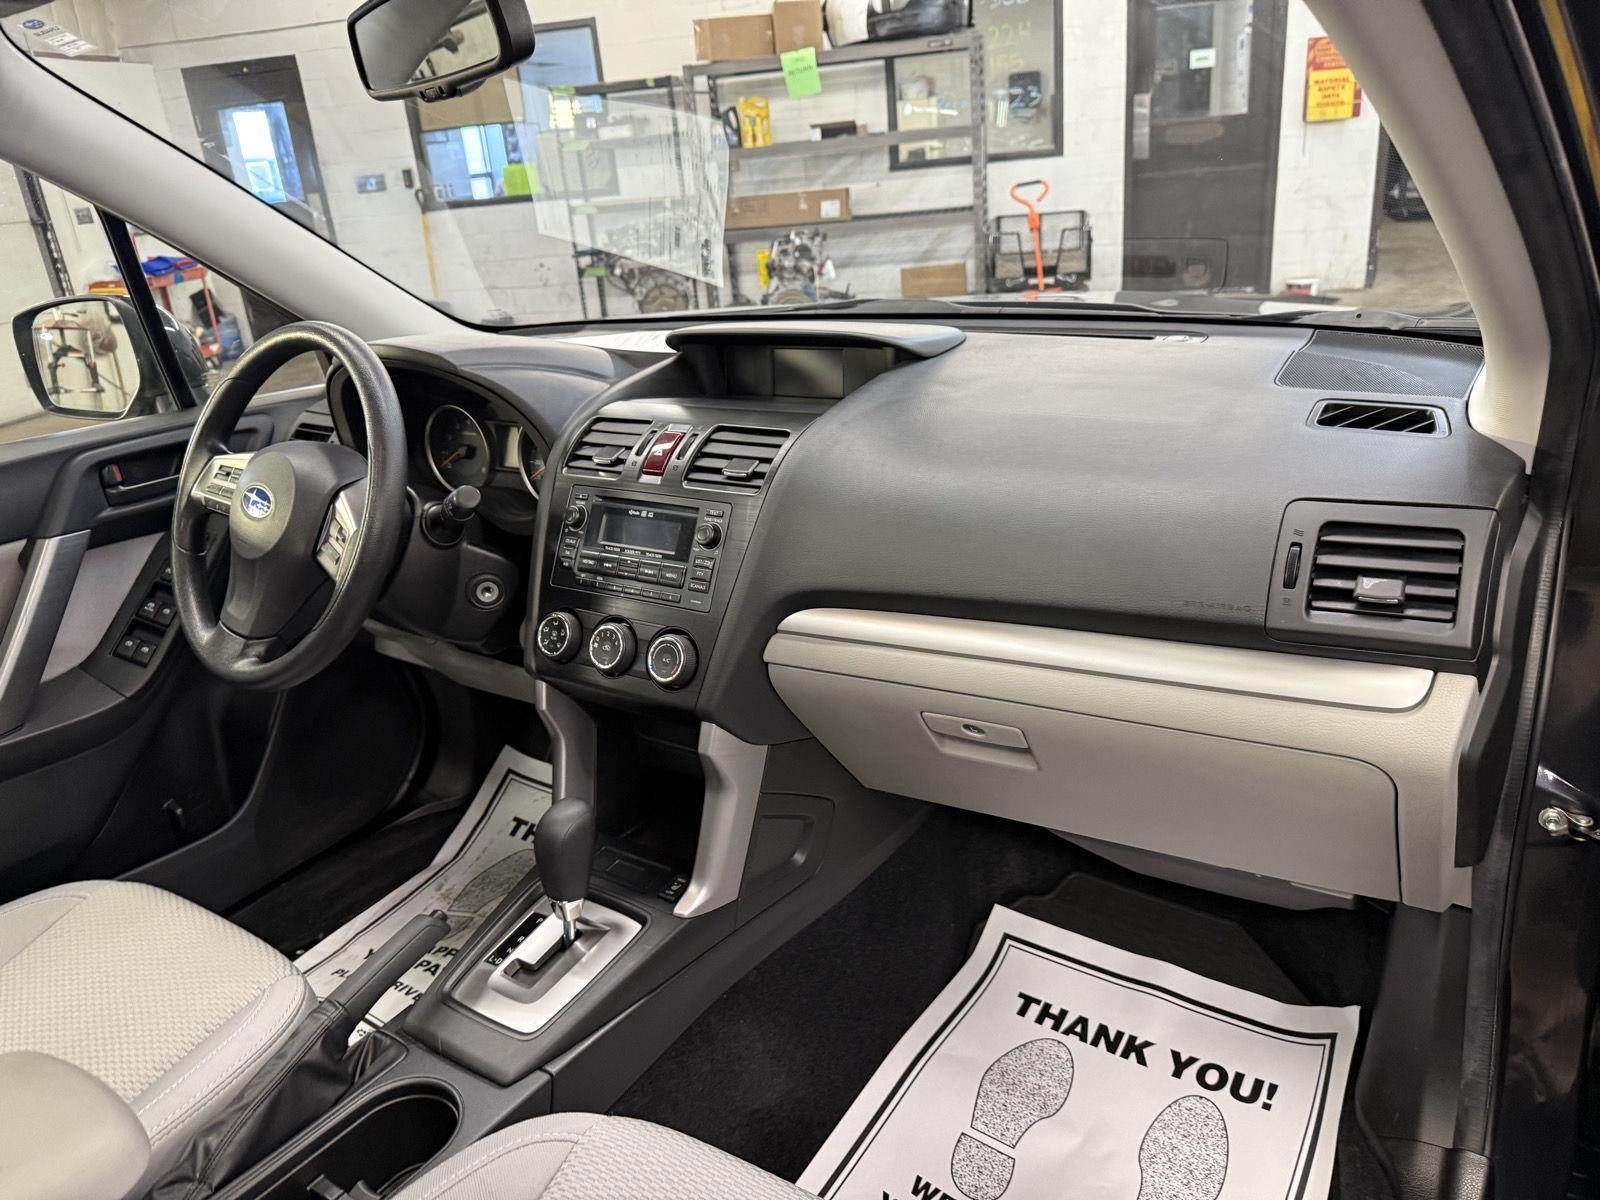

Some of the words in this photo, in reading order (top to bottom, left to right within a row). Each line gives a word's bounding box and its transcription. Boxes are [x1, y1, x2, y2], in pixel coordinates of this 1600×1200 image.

[1314, 76, 1350, 84] MATERIAL
[509, 816, 537, 844] TH
[414, 959, 441, 976] PA
[1016, 991, 1157, 1068] THANK
[1170, 1048, 1279, 1112] YOU!
[911, 1174, 957, 1200] W
